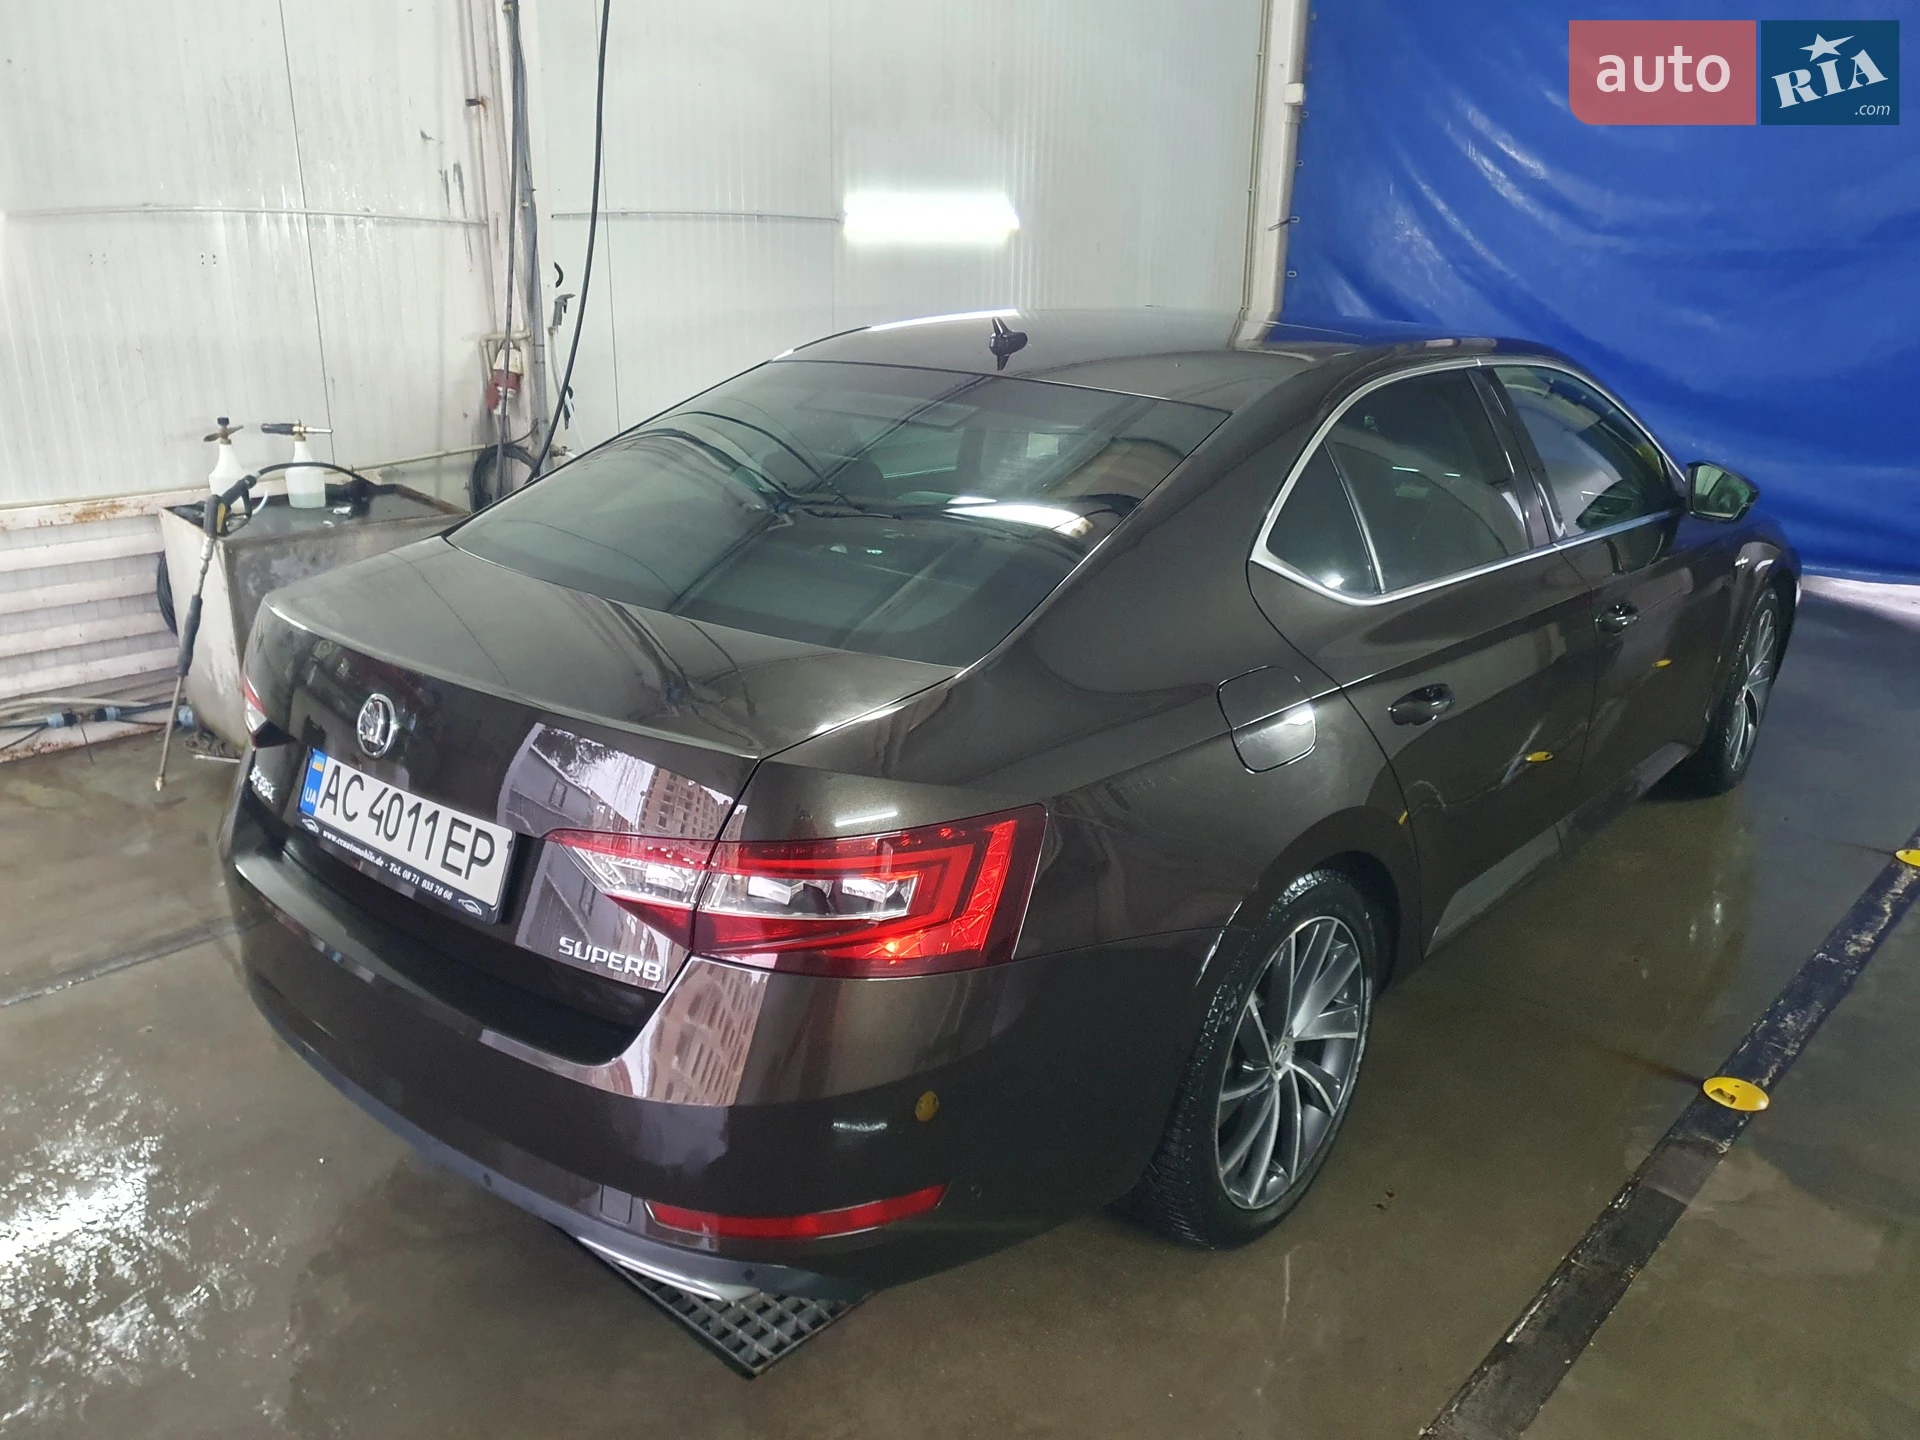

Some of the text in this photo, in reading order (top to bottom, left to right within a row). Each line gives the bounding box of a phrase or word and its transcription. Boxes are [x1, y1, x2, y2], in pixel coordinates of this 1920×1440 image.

[304, 787, 317, 806] UA
[319, 764, 365, 823] AC
[367, 787, 441, 861] 4011
[440, 816, 495, 881] EP
[389, 862, 402, 877] Tel.
[411, 873, 420, 885] 71
[558, 936, 662, 982] SUPERB
